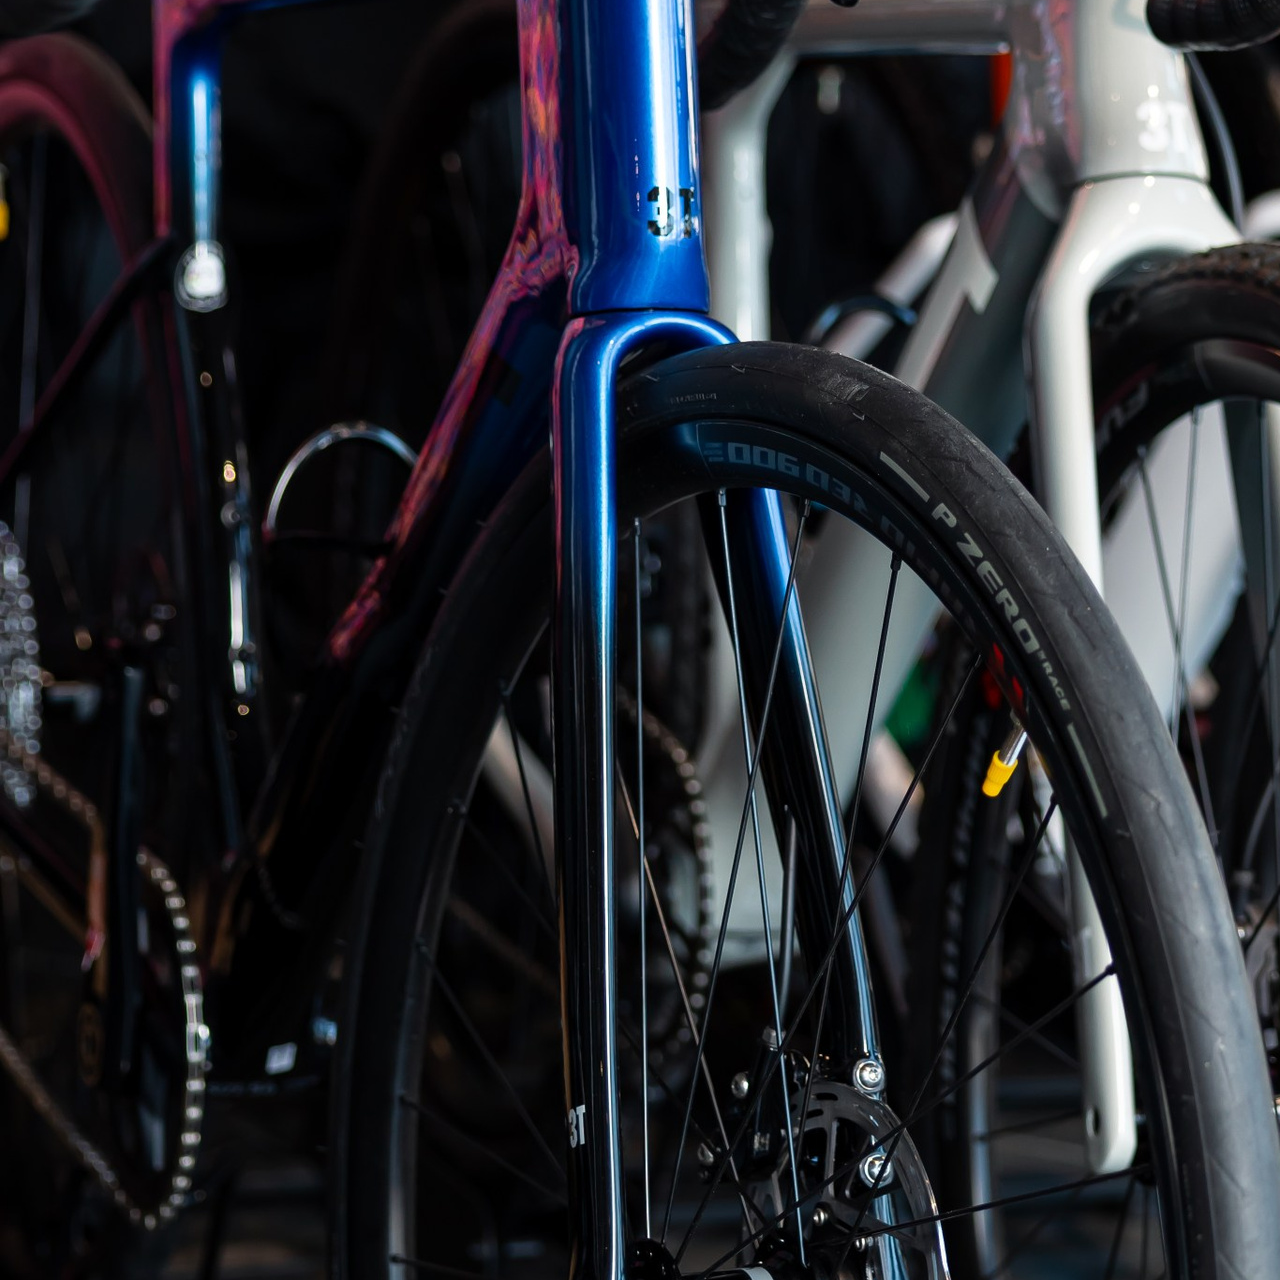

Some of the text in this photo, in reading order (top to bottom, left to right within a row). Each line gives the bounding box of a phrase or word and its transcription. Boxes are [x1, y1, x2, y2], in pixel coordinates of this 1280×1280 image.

[646, 186, 695, 239] 3T
[1041, 658, 1071, 711] RACE
[568, 1104, 586, 1149] 3T
